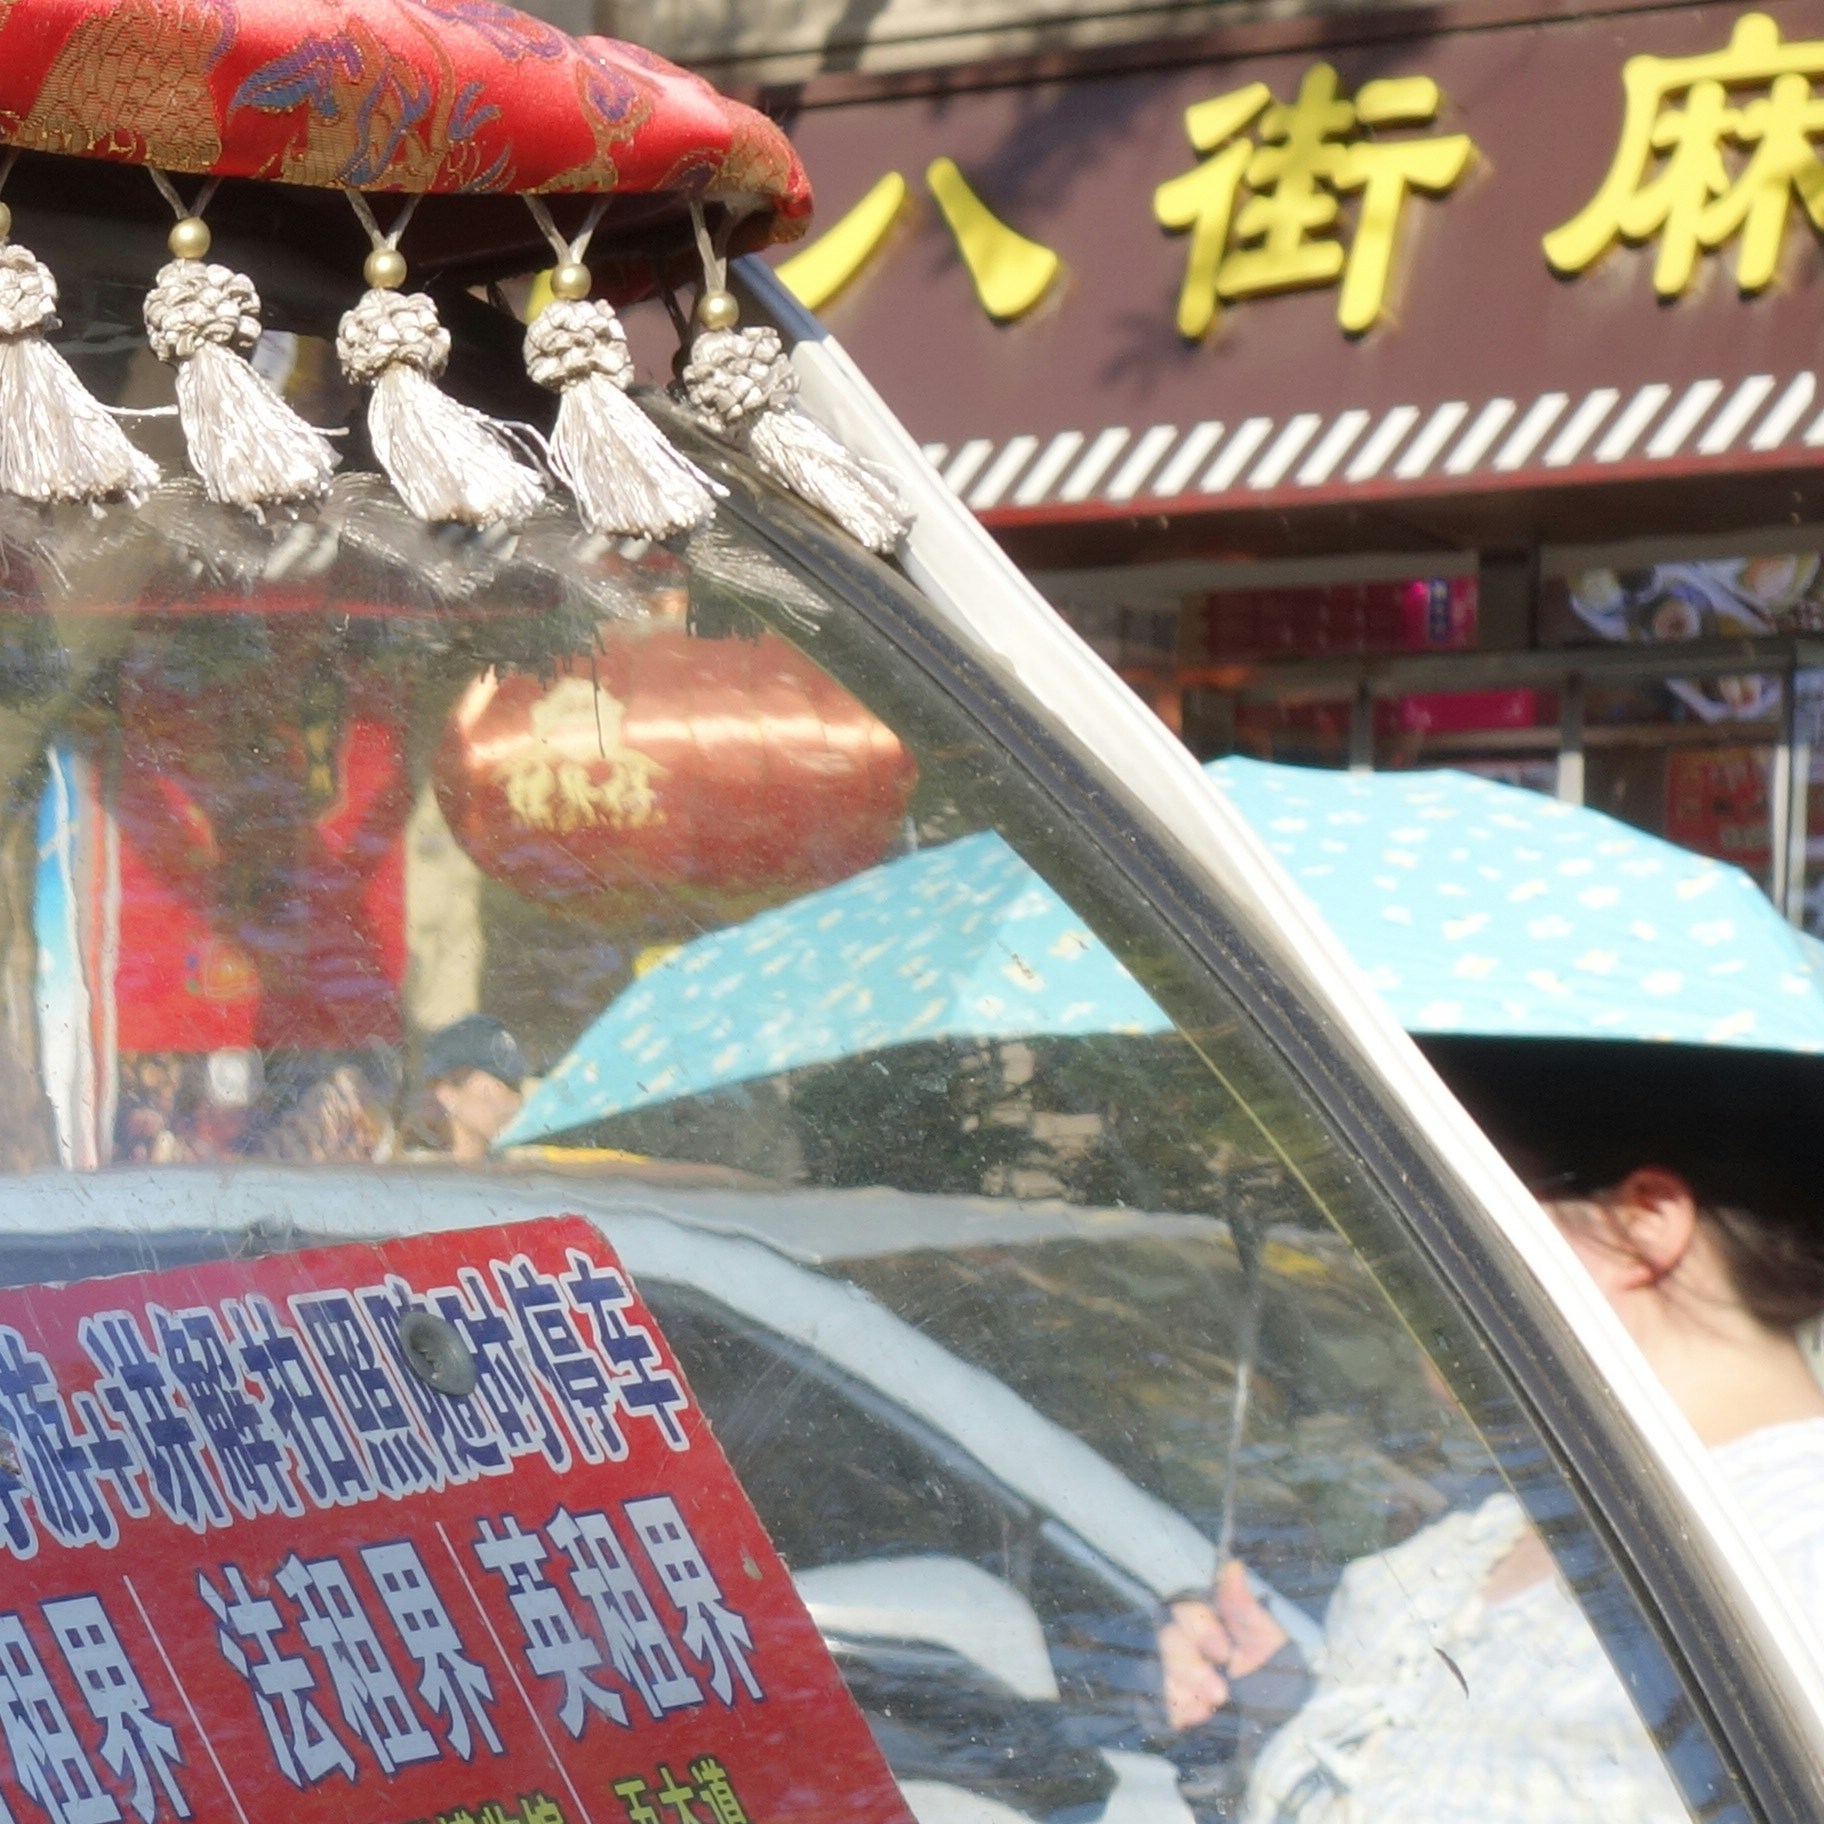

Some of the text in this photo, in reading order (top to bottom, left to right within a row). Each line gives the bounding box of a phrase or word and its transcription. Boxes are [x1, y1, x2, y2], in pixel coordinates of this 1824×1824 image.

[197, 1543, 500, 1792] 法租界
[472, 1493, 764, 1742] 英租界
